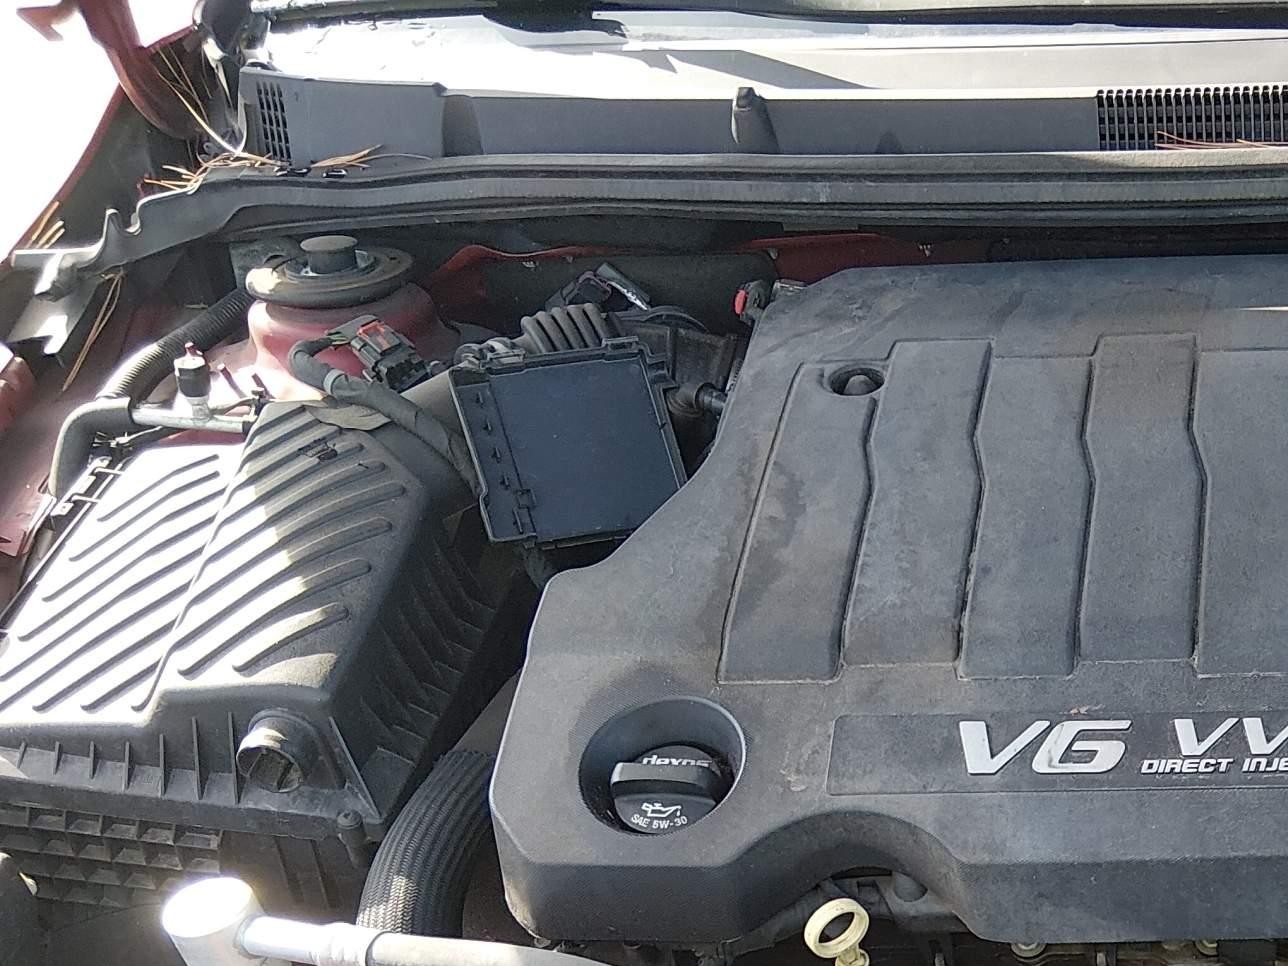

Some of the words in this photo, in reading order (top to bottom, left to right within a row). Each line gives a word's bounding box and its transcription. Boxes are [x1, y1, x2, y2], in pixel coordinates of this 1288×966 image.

[959, 720, 1132, 775] V6
[1140, 758, 1234, 773] DIRECT
[631, 813, 650, 828] SAE
[652, 815, 688, 829] 5W-30
